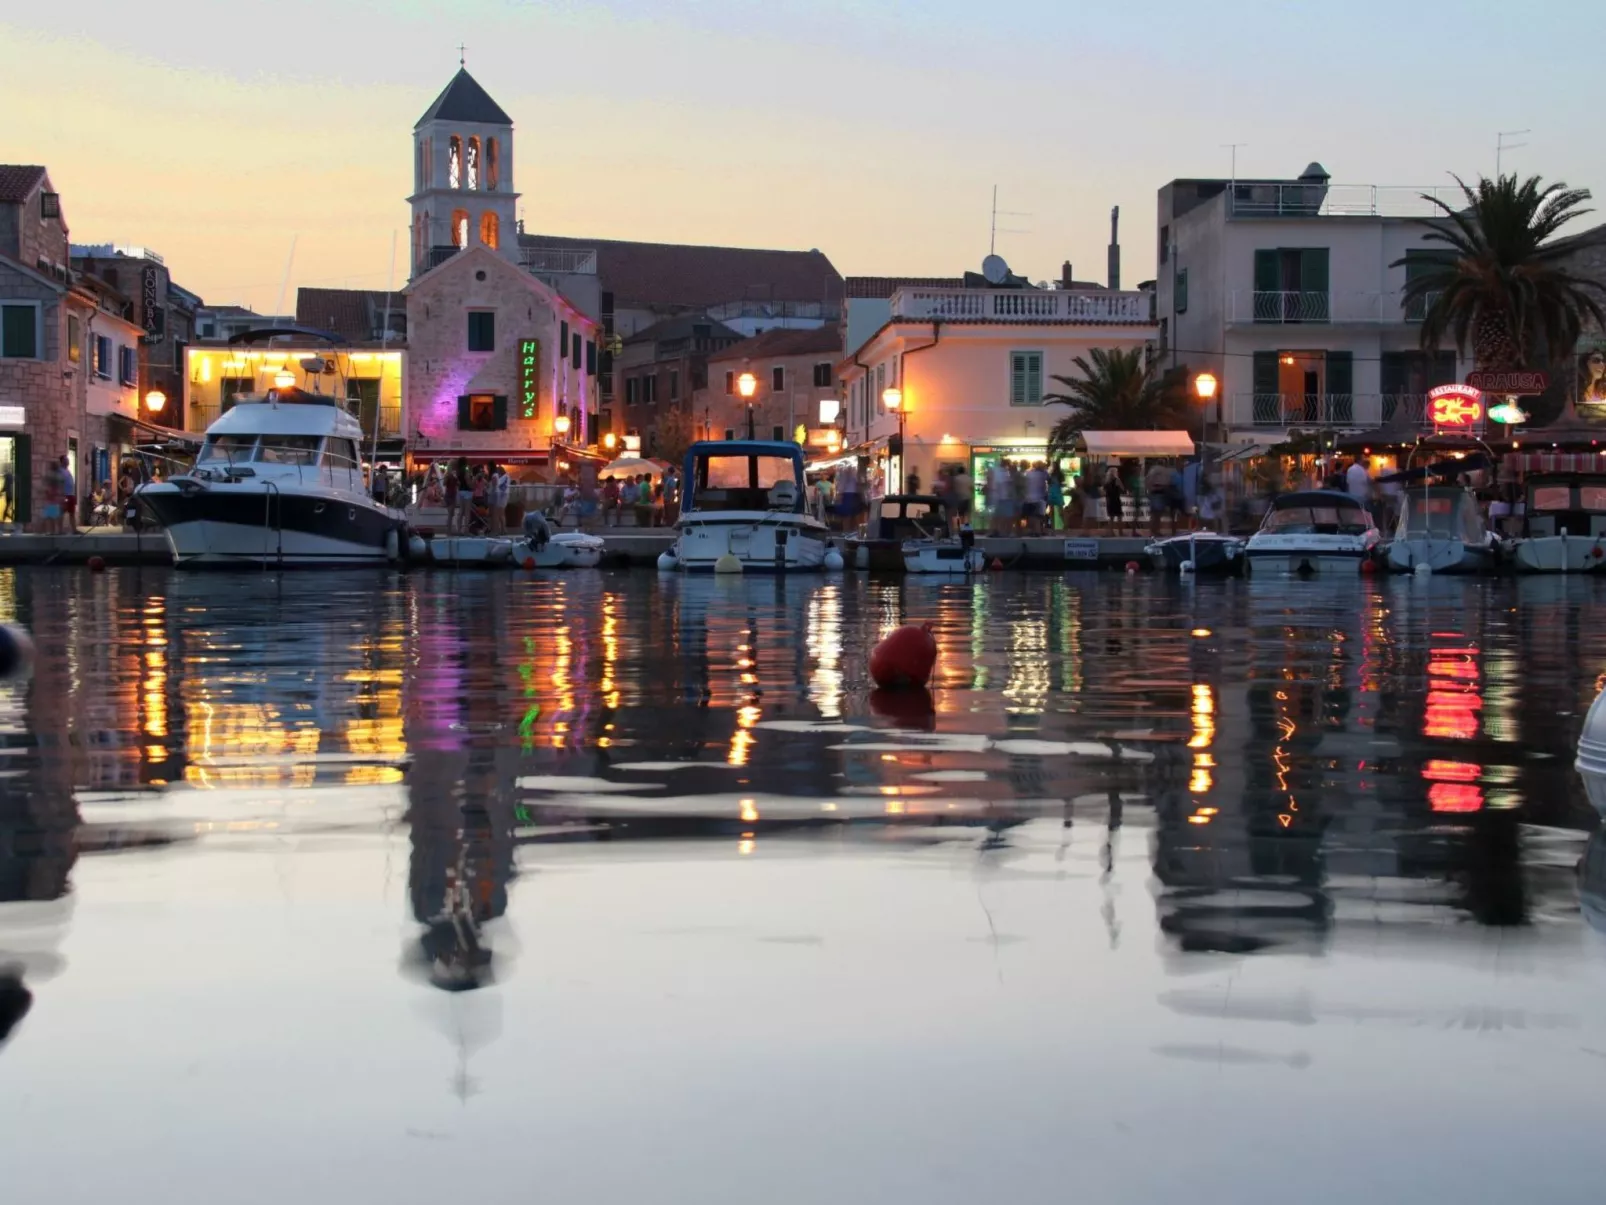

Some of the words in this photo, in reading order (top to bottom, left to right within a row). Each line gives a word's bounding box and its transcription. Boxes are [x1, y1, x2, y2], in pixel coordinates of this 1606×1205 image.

[145, 268, 155, 327] KONOBA
[523, 342, 535, 417] Harry's
[1430, 385, 1480, 399] RESTAURANT
[1471, 373, 1545, 389] ARAUSA
